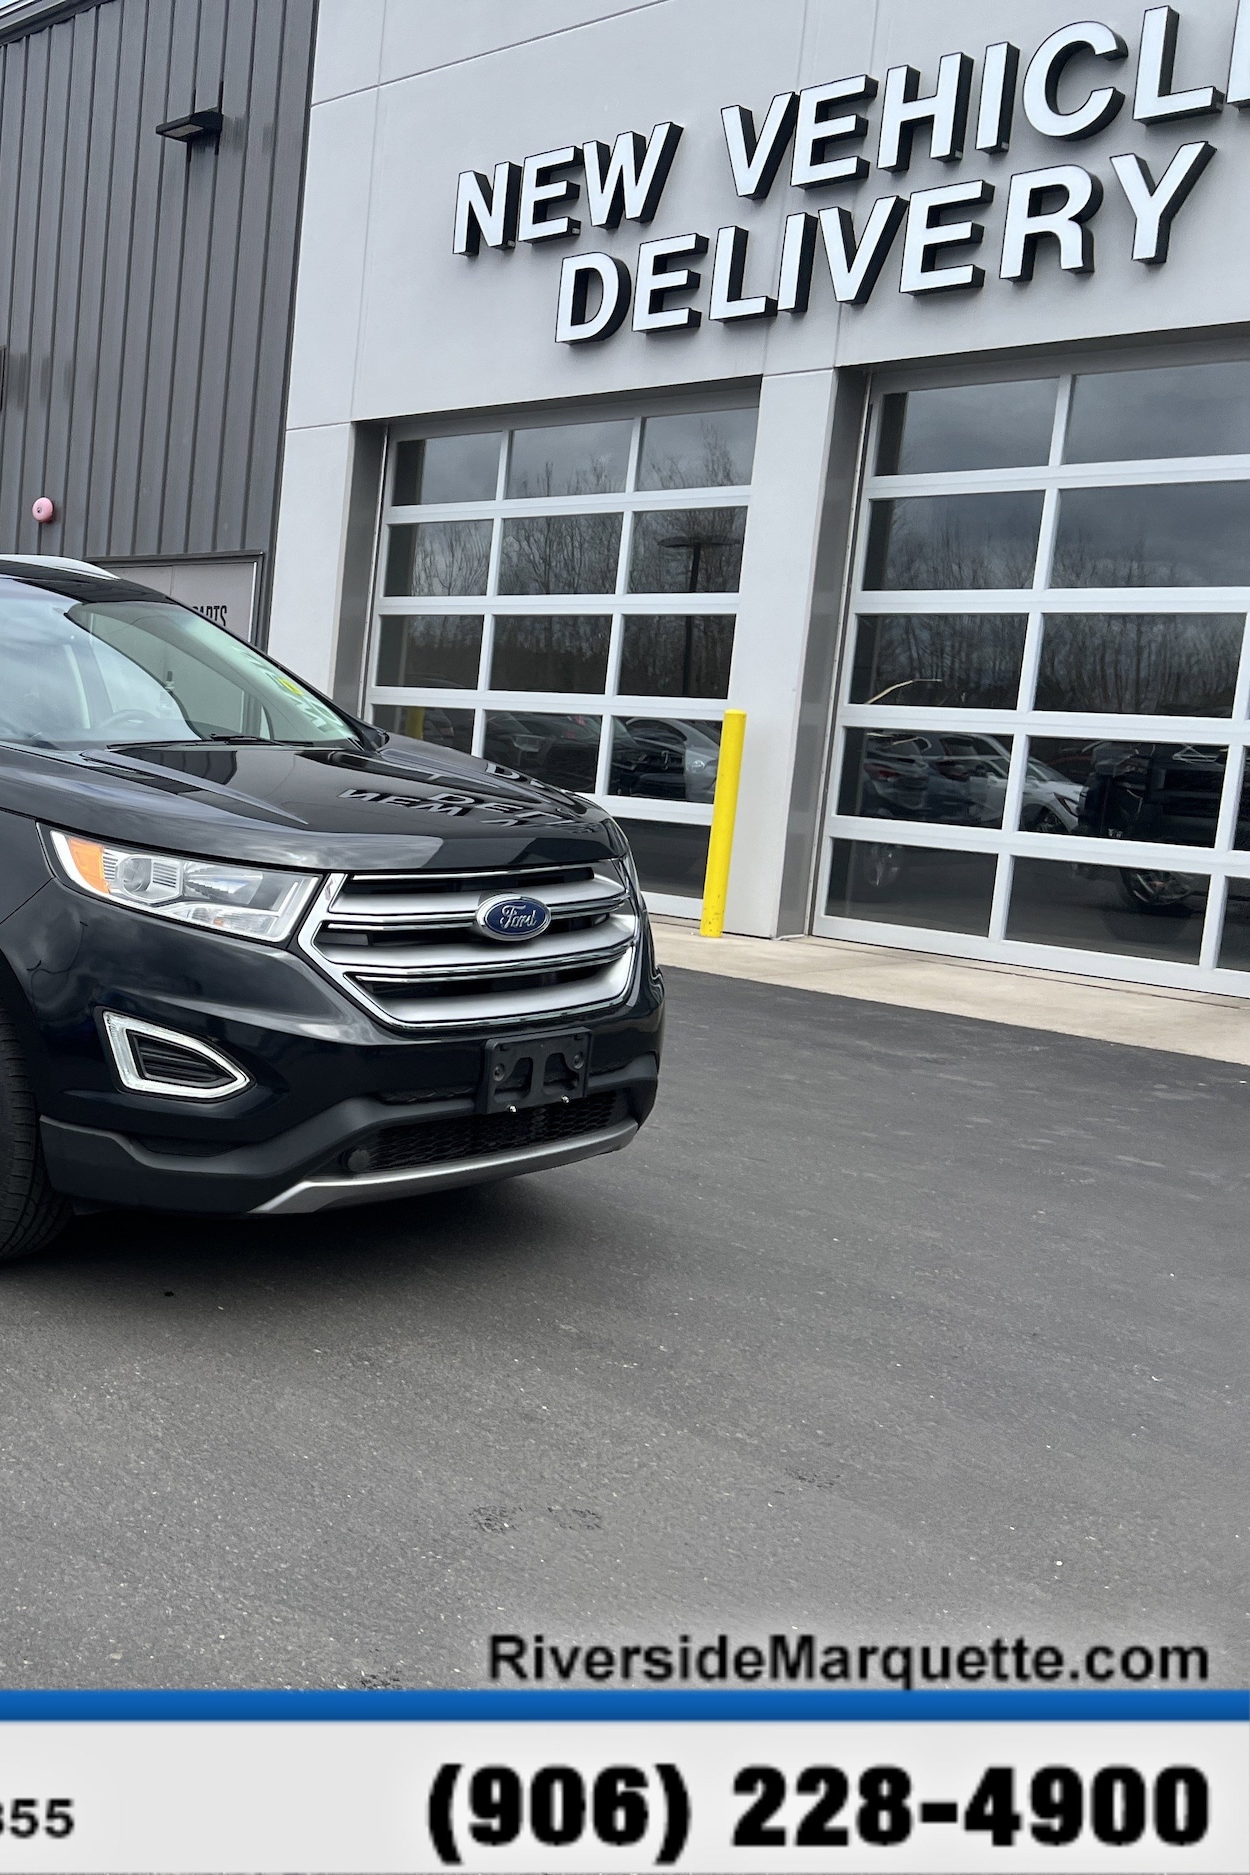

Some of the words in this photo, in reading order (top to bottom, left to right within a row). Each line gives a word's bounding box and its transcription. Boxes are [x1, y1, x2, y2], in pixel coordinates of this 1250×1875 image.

[453, 122, 683, 256] NEW
[555, 141, 1217, 345] DELIVERY
[499, 904, 537, 929] Ford
